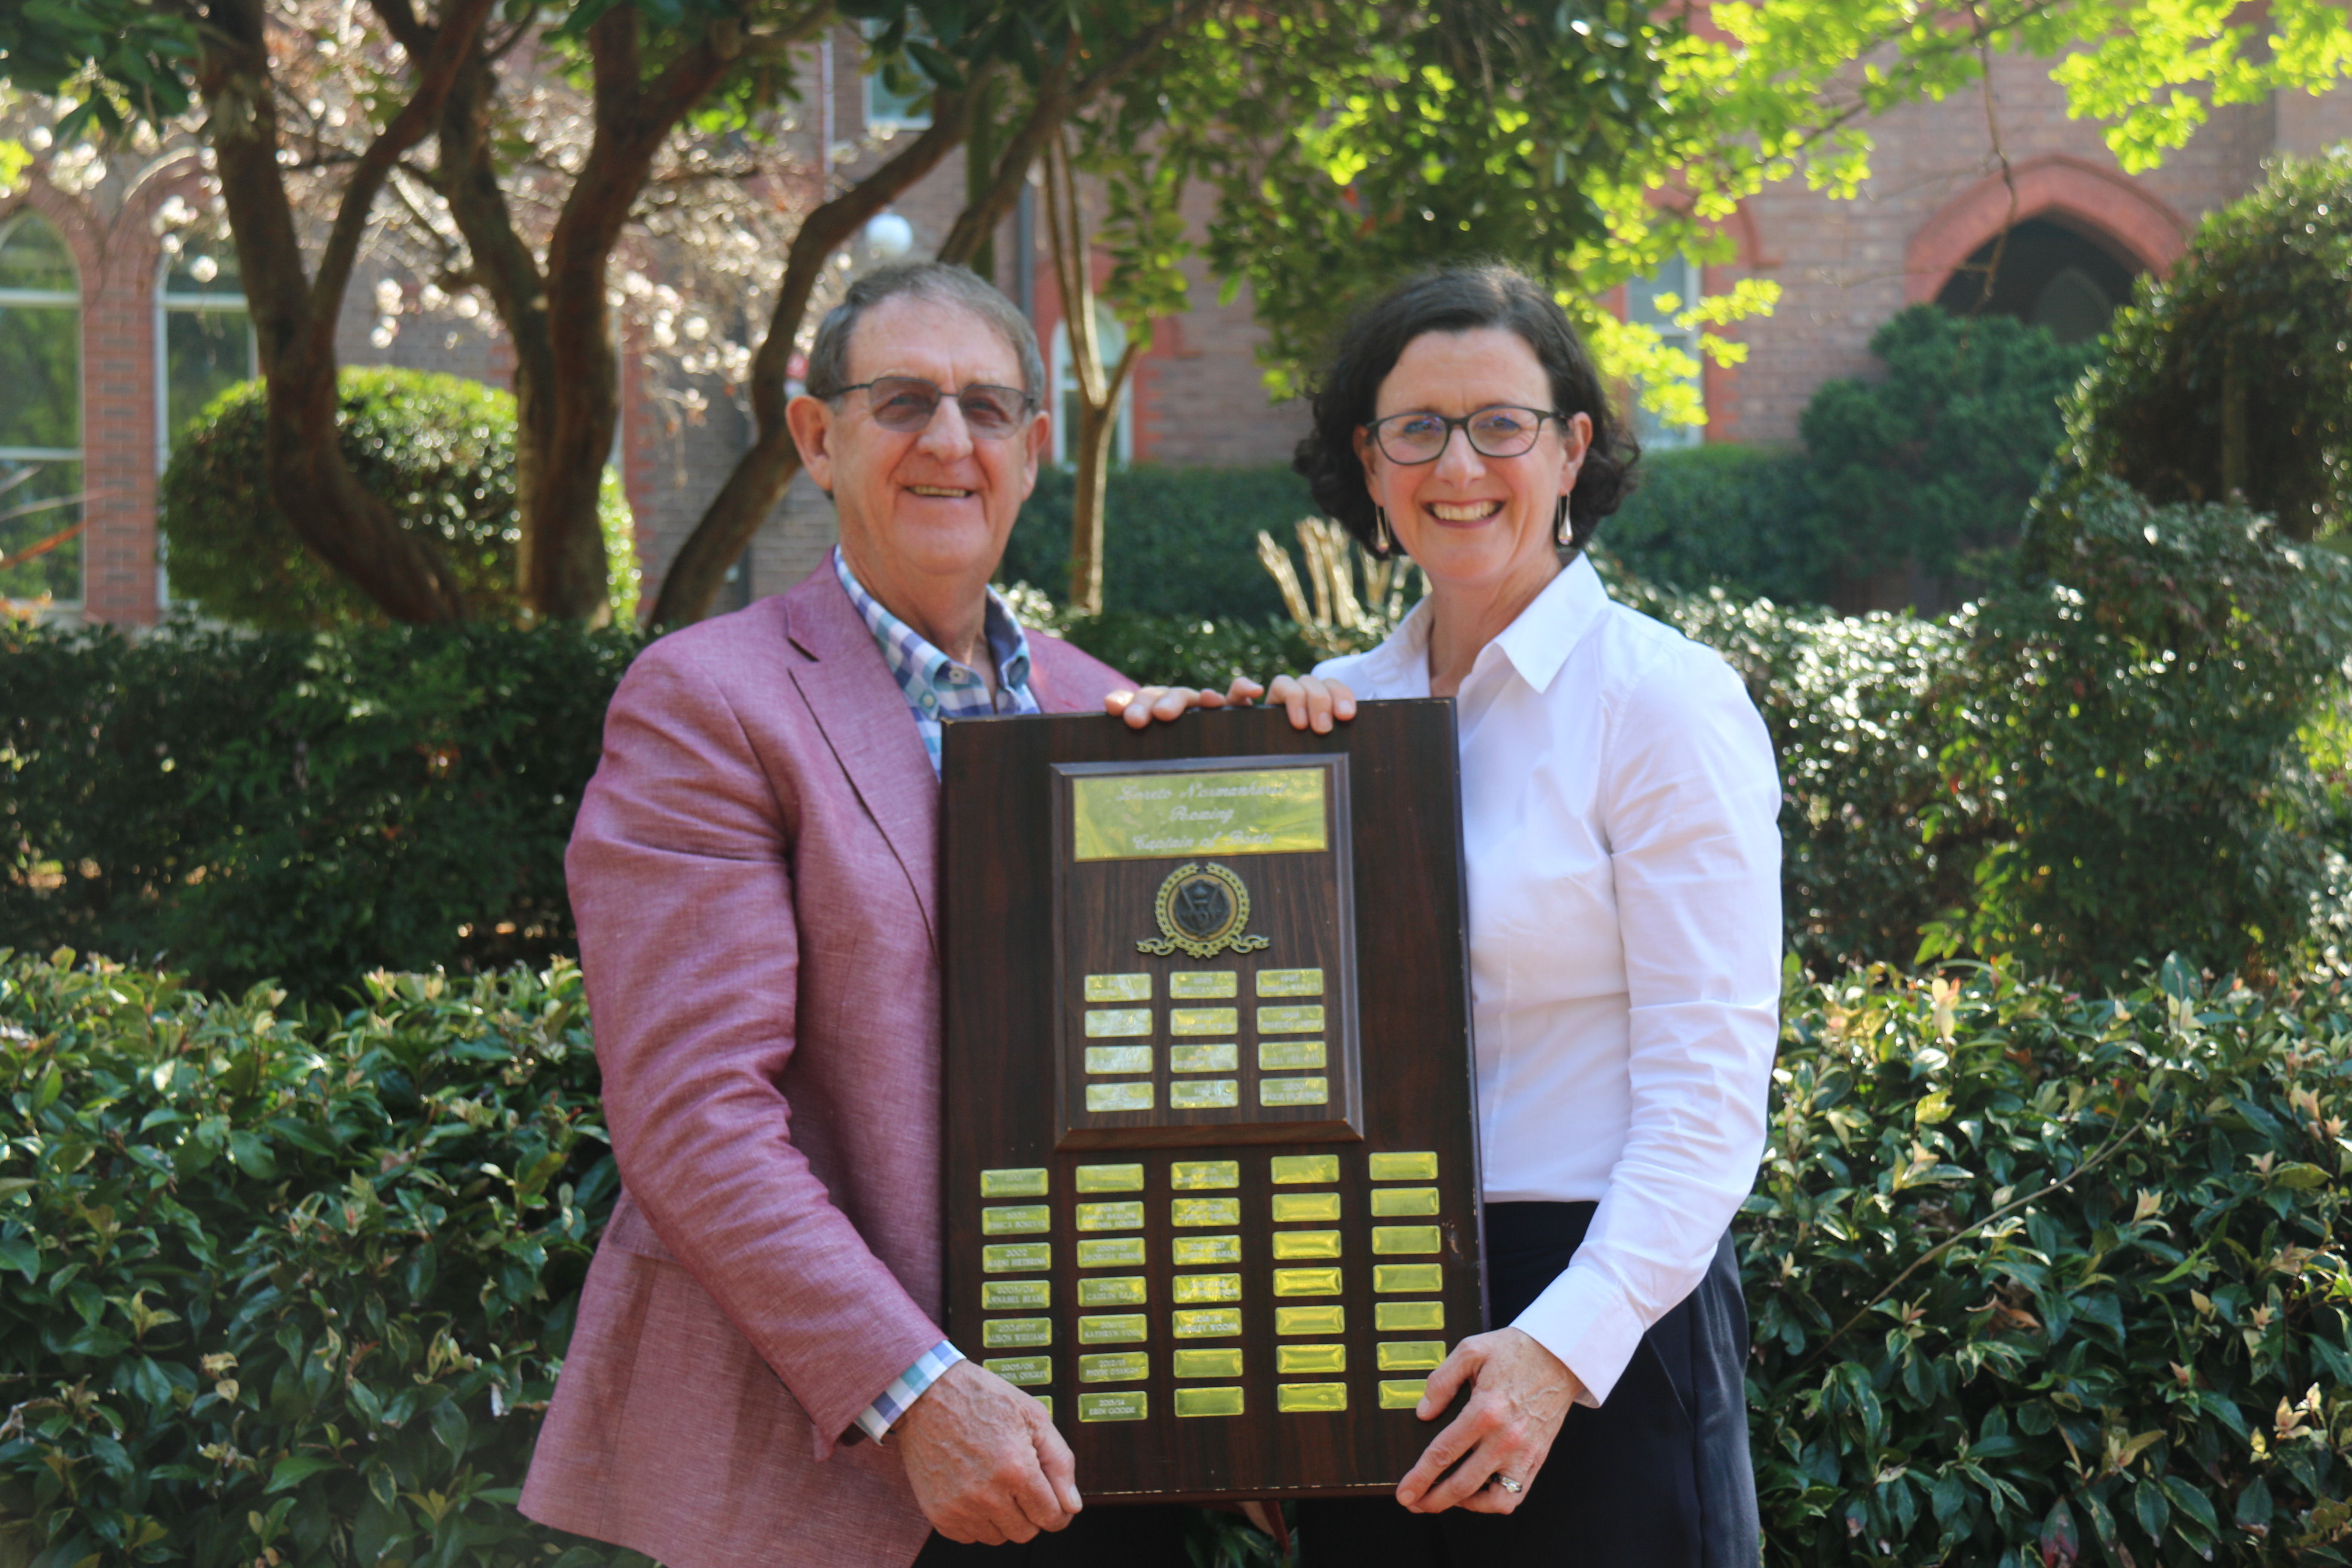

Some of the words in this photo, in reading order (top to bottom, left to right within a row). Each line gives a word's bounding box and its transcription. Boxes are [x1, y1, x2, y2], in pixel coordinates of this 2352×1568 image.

[1116, 784, 1172, 801] Loreto
[1180, 781, 1286, 799] Normanhurst
[1169, 805, 1234, 824] Rowing
[1132, 833, 1195, 852] Captain
[1199, 831, 1222, 849] of
[1224, 830, 1272, 845] Boats
[1088, 1407, 1107, 1415] ERIN
[1109, 1406, 1136, 1415] GOODE
